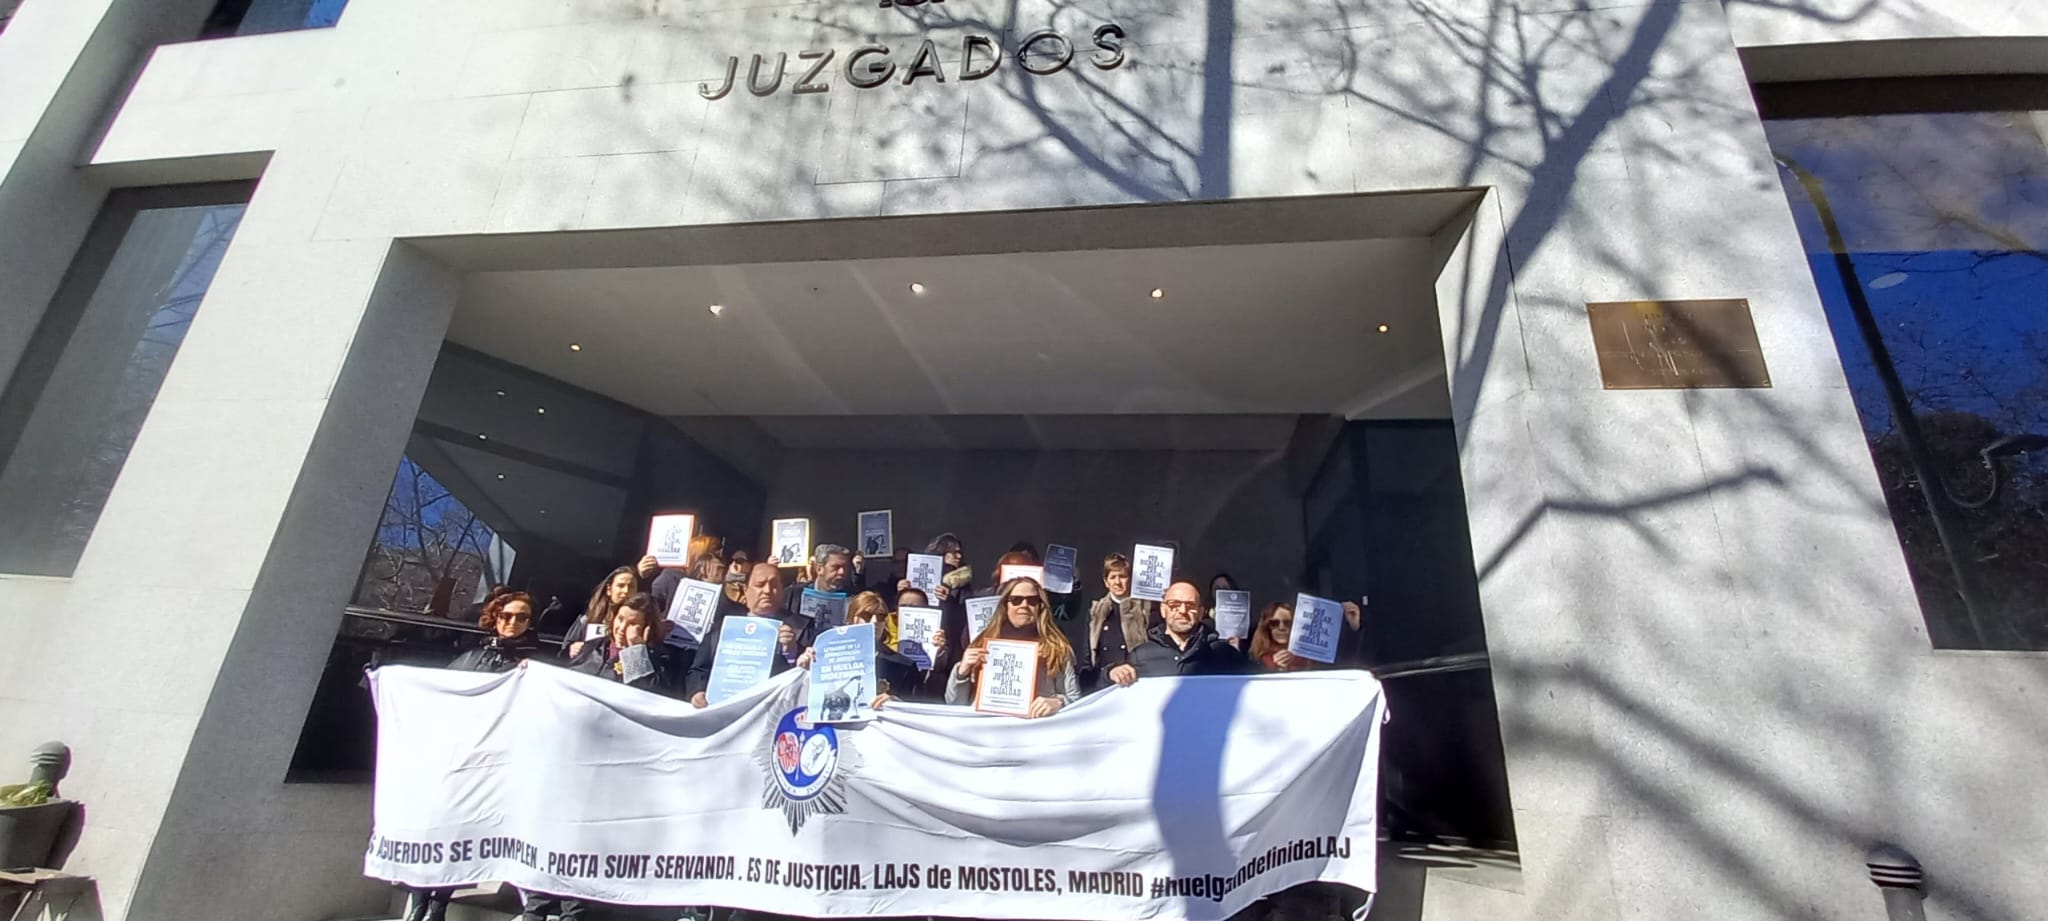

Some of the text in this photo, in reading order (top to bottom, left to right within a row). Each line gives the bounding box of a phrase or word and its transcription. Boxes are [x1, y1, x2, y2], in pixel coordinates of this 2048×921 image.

[698, 23, 1126, 100] JUZGADOS
[450, 840, 473, 862] SE
[548, 851, 598, 878] PACTA
[604, 854, 651, 879] SUNT
[654, 854, 735, 880] SERVANDA
[747, 857, 762, 882] ES
[765, 858, 781, 885] DE
[783, 862, 866, 890] JUSTICIA.
[873, 863, 920, 890] LAJS
[926, 864, 951, 889] de
[958, 866, 1062, 895] MOSTOLES,
[1068, 870, 1144, 897] MADRID
